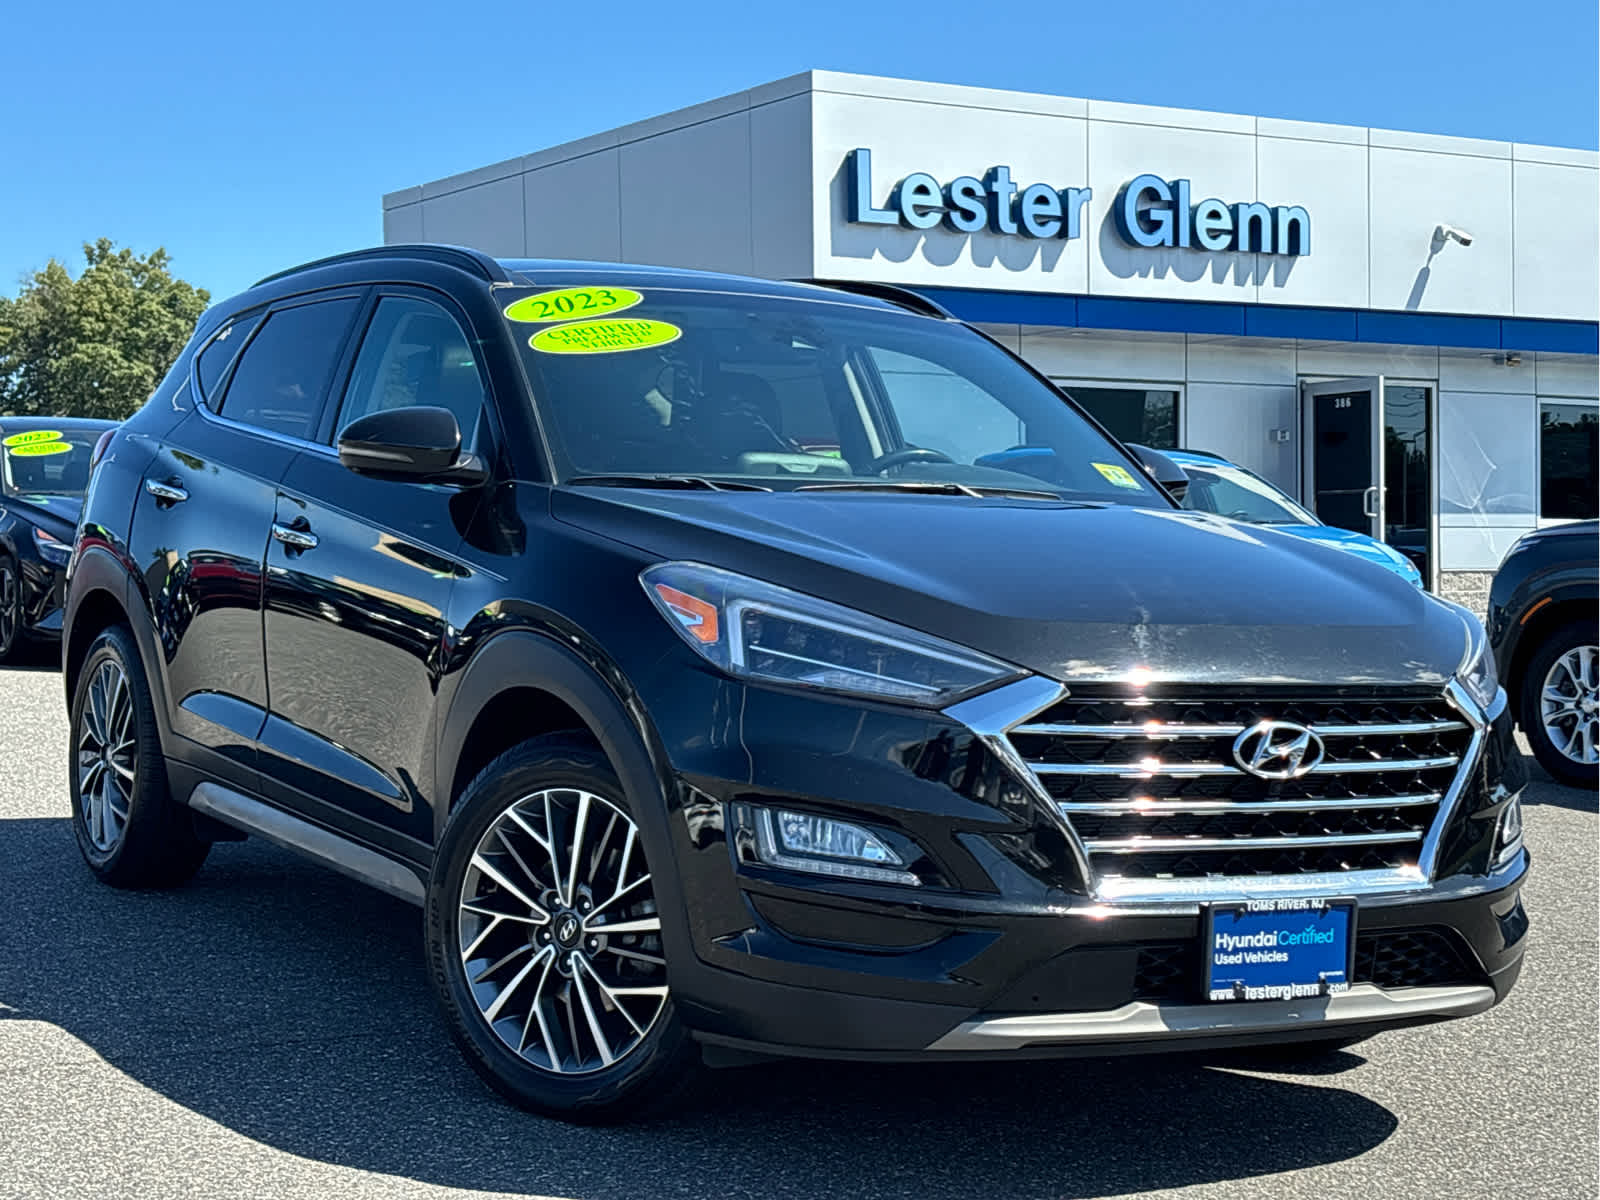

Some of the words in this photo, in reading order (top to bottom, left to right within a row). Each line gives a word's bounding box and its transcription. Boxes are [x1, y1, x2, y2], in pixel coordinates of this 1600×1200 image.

[848, 148, 1092, 240] Lester
[1115, 174, 1311, 256] Glenn
[532, 290, 617, 318] 2023
[547, 323, 652, 340] CERTIFIED
[580, 337, 644, 348] VEHICLE
[1247, 900, 1275, 911] TOMS
[1311, 899, 1325, 909] NJ
[1215, 931, 1278, 951] Hyundai
[1278, 926, 1335, 946] Certified
[1214, 953, 1243, 965] Used
[1244, 951, 1289, 964] Vehicles
